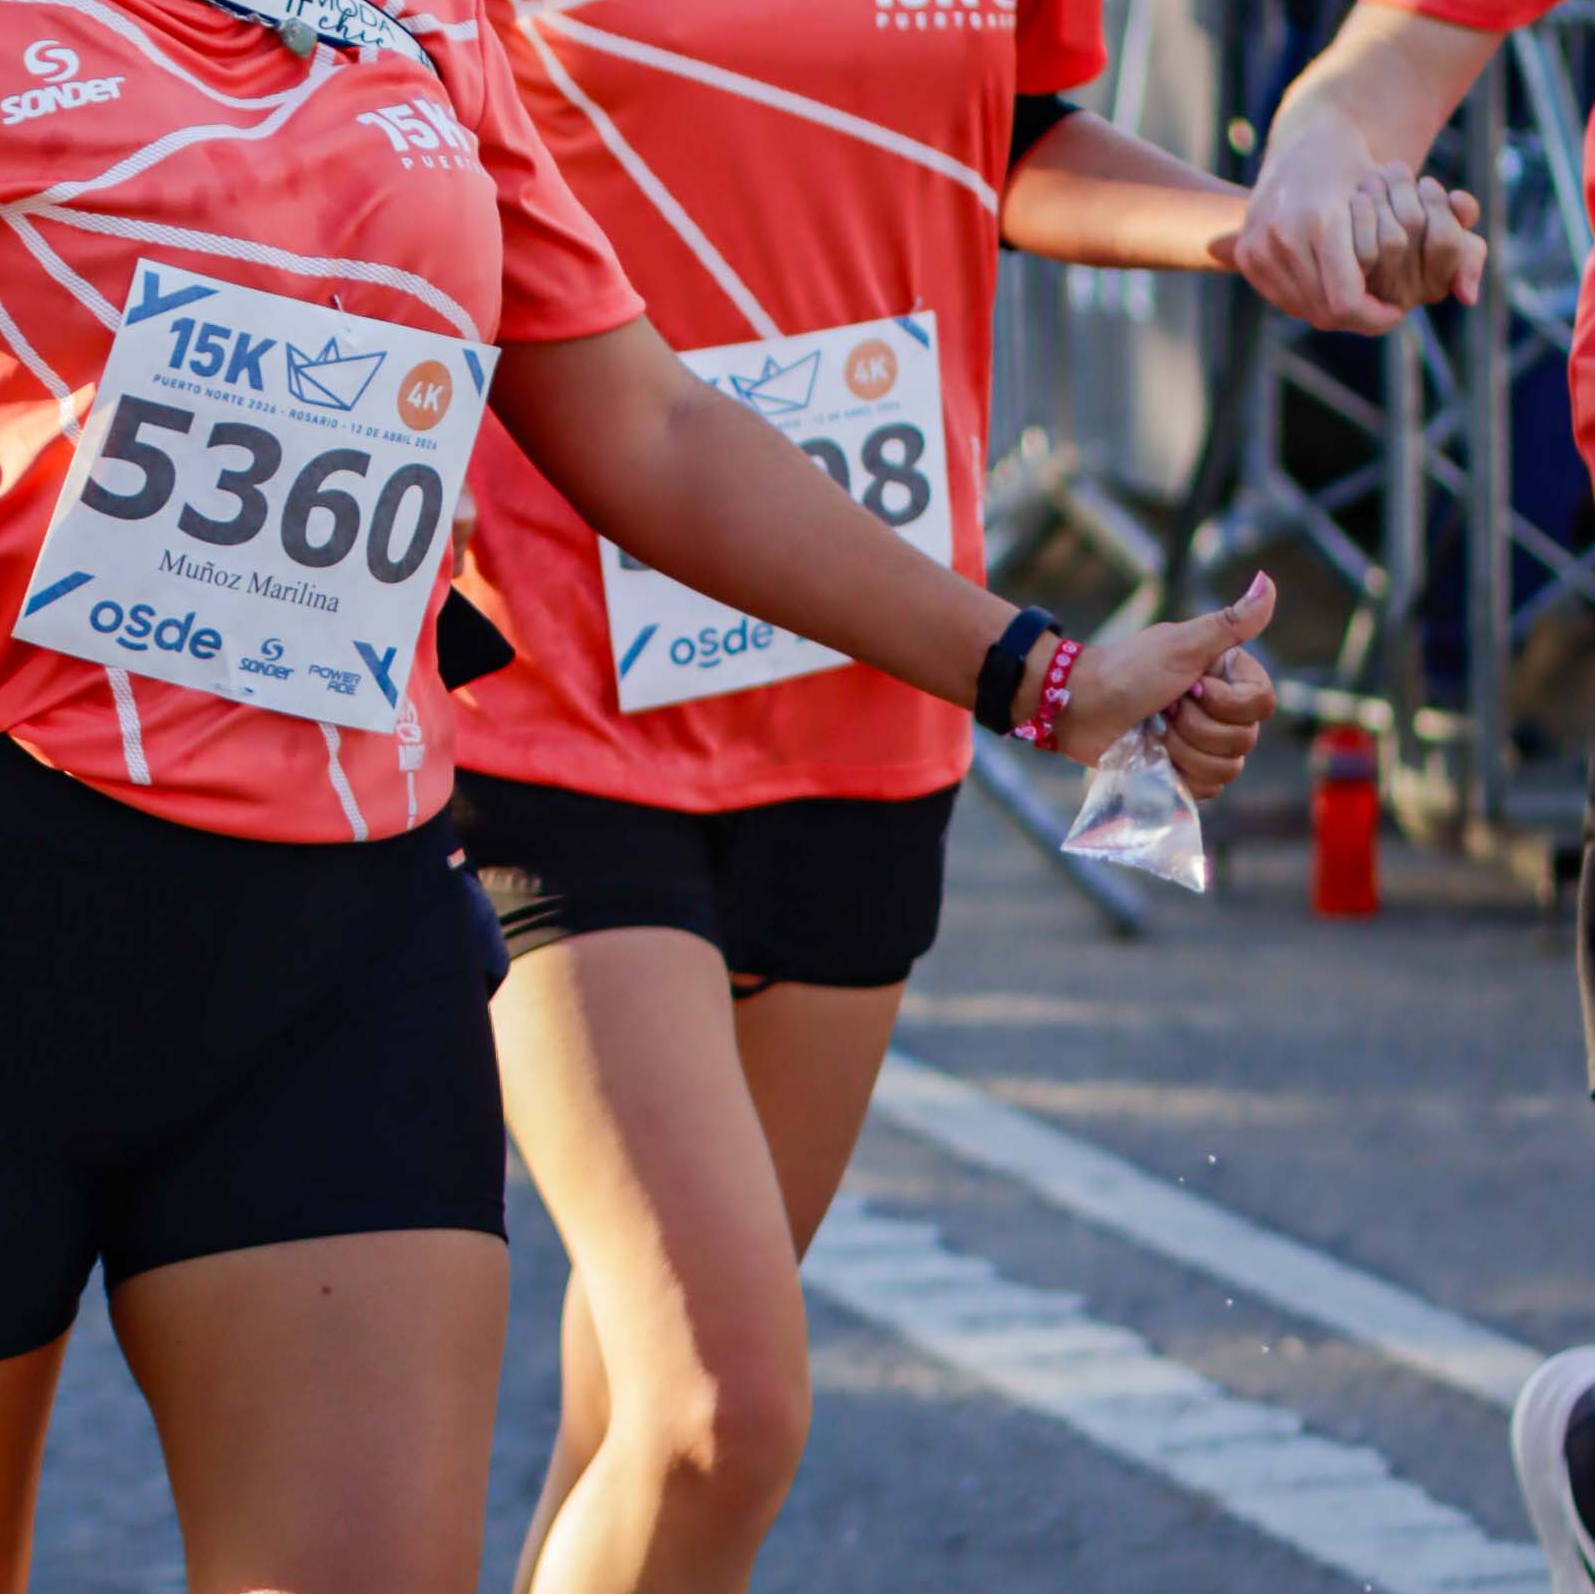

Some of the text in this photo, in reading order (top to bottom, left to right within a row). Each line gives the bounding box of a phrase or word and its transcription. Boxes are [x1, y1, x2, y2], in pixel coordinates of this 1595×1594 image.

[318, 7, 384, 47] chic
[357, 99, 471, 153] 15K
[168, 317, 277, 391] 15K
[854, 356, 888, 384] 4K
[153, 374, 202, 394] PUERTO
[206, 388, 245, 406] NORTE
[288, 408, 339, 429] ROSARIO
[350, 423, 363, 434] 12
[366, 427, 380, 438] DE
[382, 431, 410, 445] ABRIL
[406, 381, 445, 413] 4K
[80, 393, 444, 584] 5360
[158, 549, 340, 613] Muñoz Marilina
[90, 600, 222, 659] osde
[670, 616, 774, 668] osde
[308, 663, 362, 684] POWER
